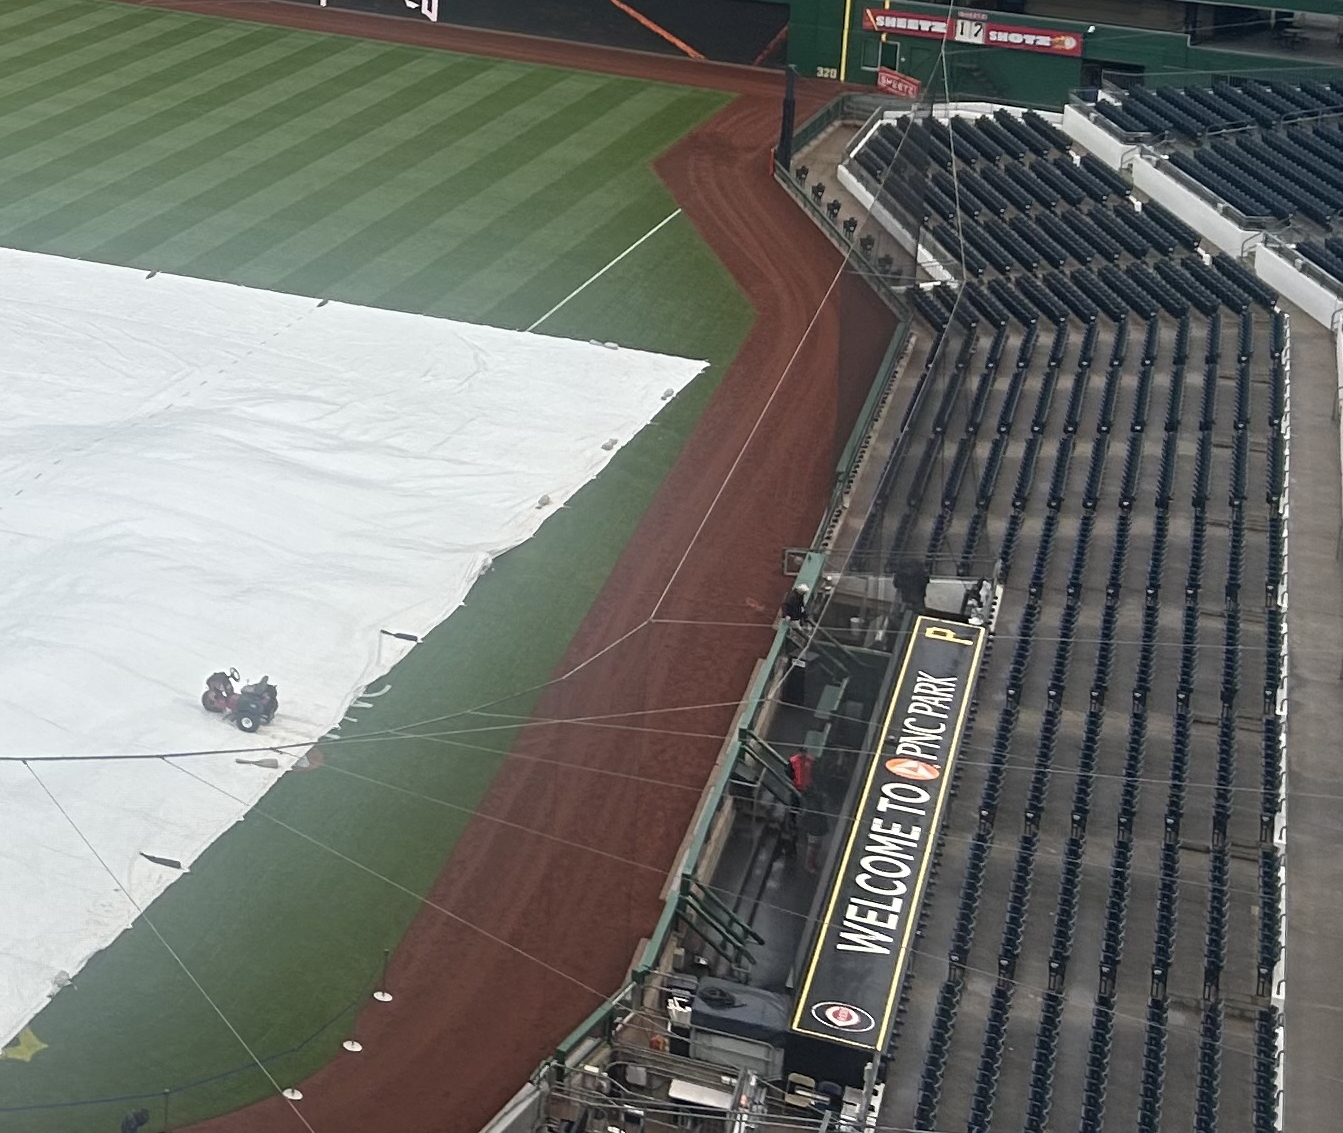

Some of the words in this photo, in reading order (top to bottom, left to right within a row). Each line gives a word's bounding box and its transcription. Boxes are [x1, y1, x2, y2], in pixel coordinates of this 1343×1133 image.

[875, 15, 947, 33] SHEETZ
[989, 31, 1052, 46] SHOTZ
[817, 66, 837, 79] 320
[918, 670, 958, 719] PARK
[897, 718, 946, 766] PNC
[878, 782, 931, 817] TO
[836, 819, 920, 955] WELCOME
